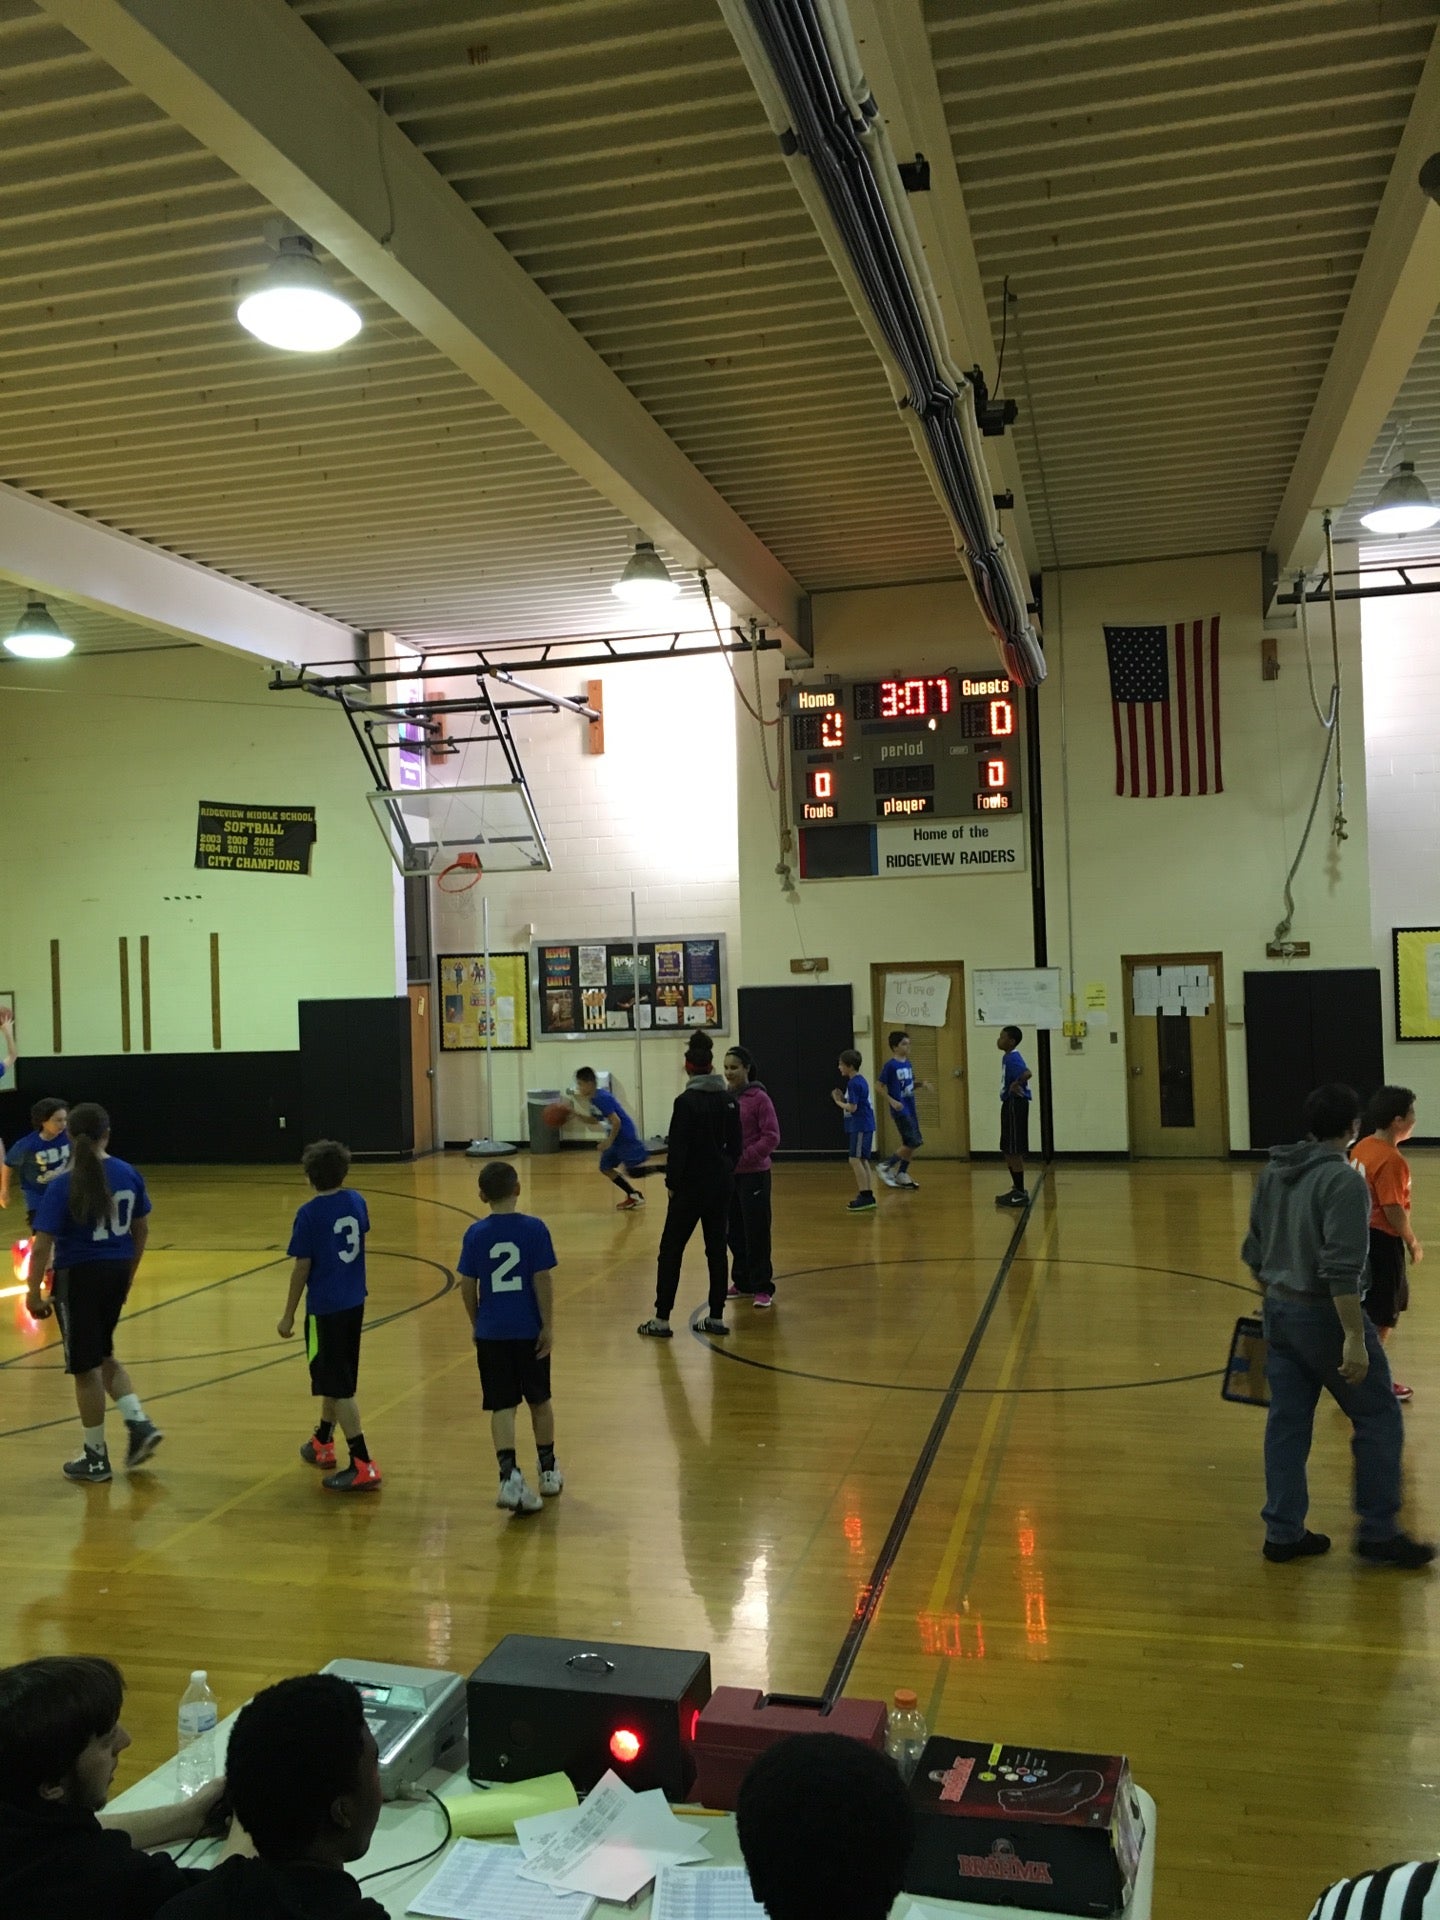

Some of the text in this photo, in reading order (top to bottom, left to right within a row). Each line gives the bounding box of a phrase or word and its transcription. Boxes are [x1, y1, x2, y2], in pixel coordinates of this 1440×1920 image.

[962, 679, 1009, 696] Guests
[799, 692, 835, 708] Home
[882, 679, 948, 717] 3:07
[990, 700, 1012, 735] 0
[881, 741, 923, 760] period
[815, 772, 831, 797] 0
[200, 808, 313, 822] RIDGEVIEW MIDDLE SCHOOL
[804, 803, 834, 818] fouls
[884, 797, 926, 816] player
[224, 821, 284, 835] SOFTBALL
[913, 825, 989, 841] Home of the
[227, 845, 246, 854] 2011
[253, 847, 275, 856] 2015
[253, 837, 274, 847] 2012
[208, 856, 300, 871] CITY CHAMPIONS
[886, 849, 1015, 868] RIDGEVIEW RAIDERS
[613, 955, 648, 968] Respct
[893, 980, 936, 997] Time
[895, 1001, 931, 1018] Out
[333, 1215, 360, 1263] 3
[489, 1241, 522, 1293] 2
[958, 1854, 1053, 1884] BRAHMA
